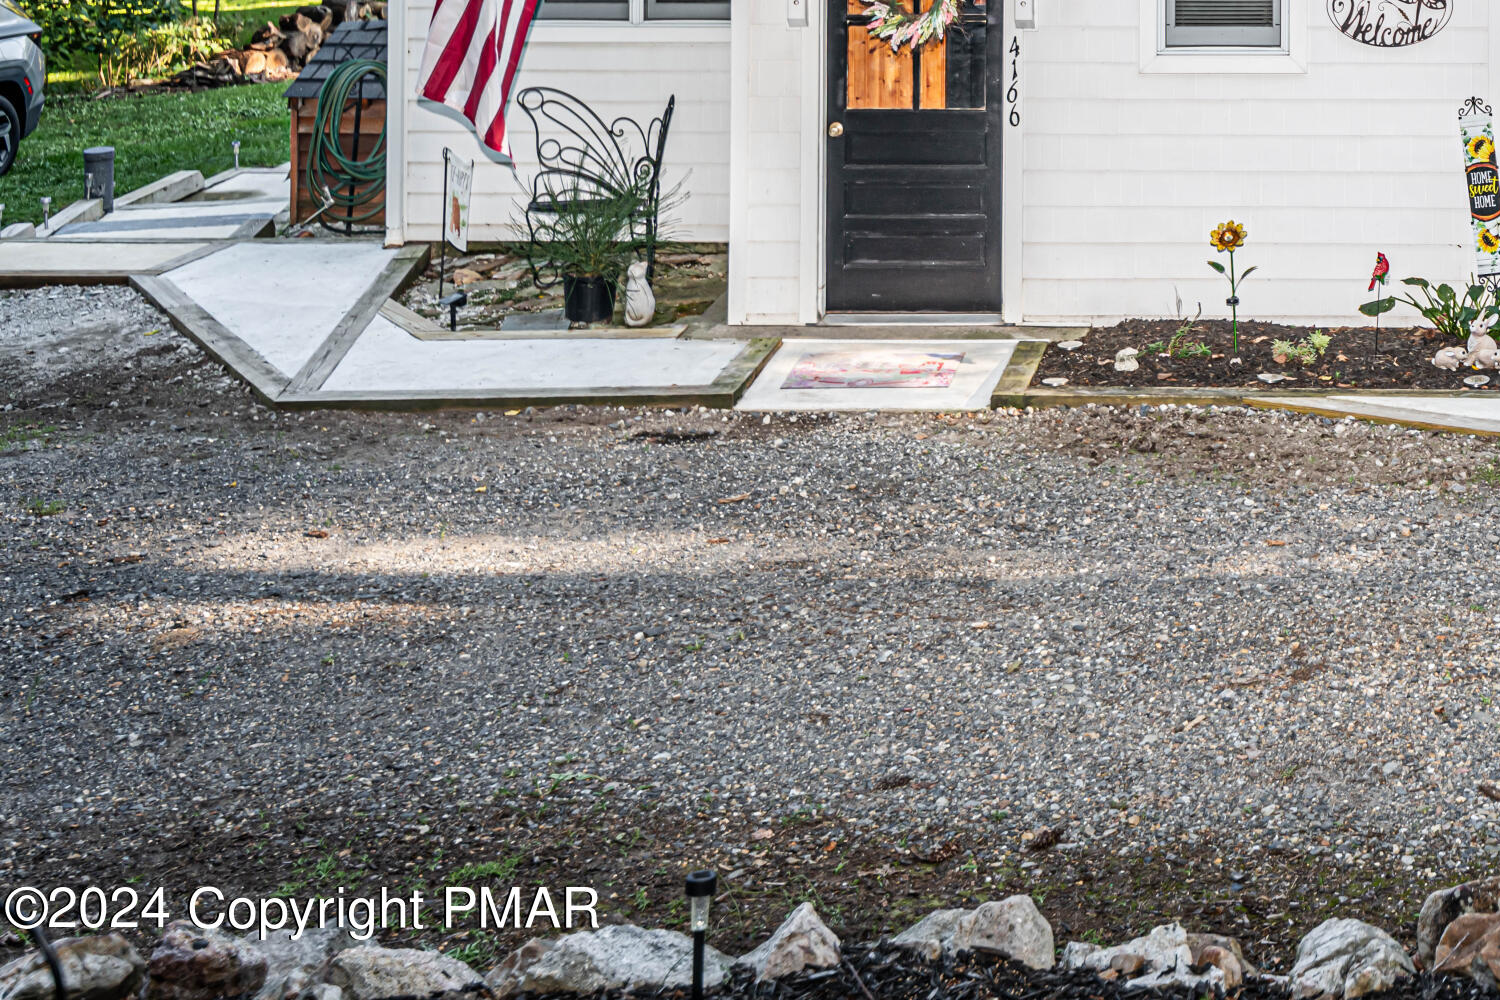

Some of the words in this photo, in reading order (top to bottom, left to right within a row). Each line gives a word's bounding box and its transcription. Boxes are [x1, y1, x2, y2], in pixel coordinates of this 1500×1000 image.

[1007, 36, 1020, 127] 4166
[1470, 170, 1493, 185] HOME
[1469, 177, 1499, 198] sweet
[1474, 194, 1497, 209] HOME
